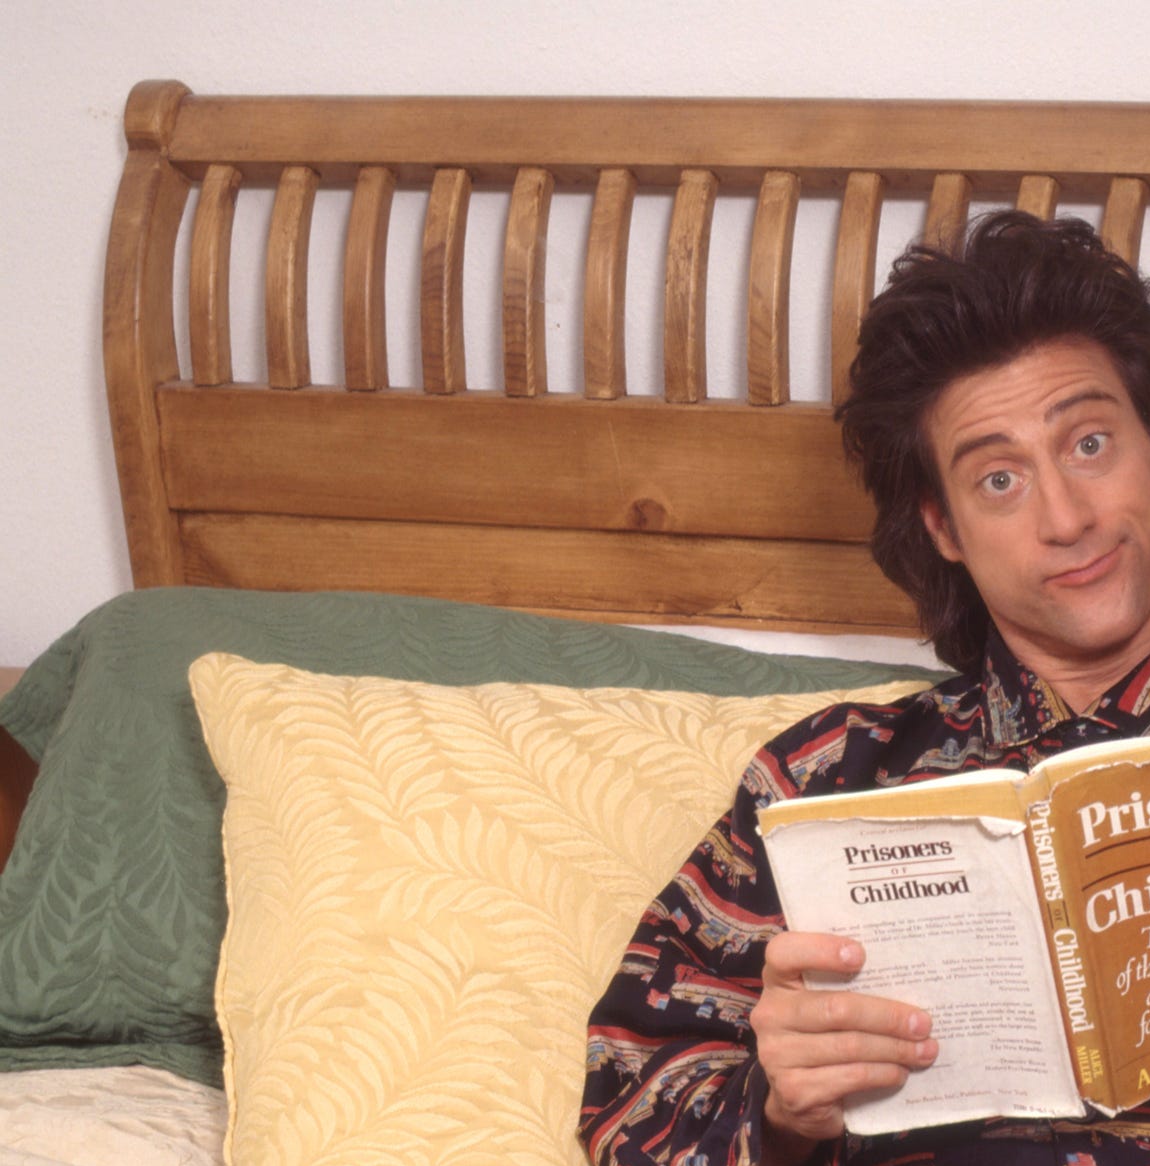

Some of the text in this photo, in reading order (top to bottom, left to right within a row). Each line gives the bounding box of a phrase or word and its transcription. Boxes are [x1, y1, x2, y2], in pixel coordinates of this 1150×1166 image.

[843, 841, 953, 865] Prisoners
[1030, 800, 1064, 901] Prisoners
[891, 867, 908, 875] OF
[850, 875, 970, 905] Childhood
[1053, 927, 1095, 1034] Childhood
[1116, 956, 1136, 996] of
[1076, 1045, 1093, 1085] MILLER
[1088, 1049, 1104, 1078] ALICE
